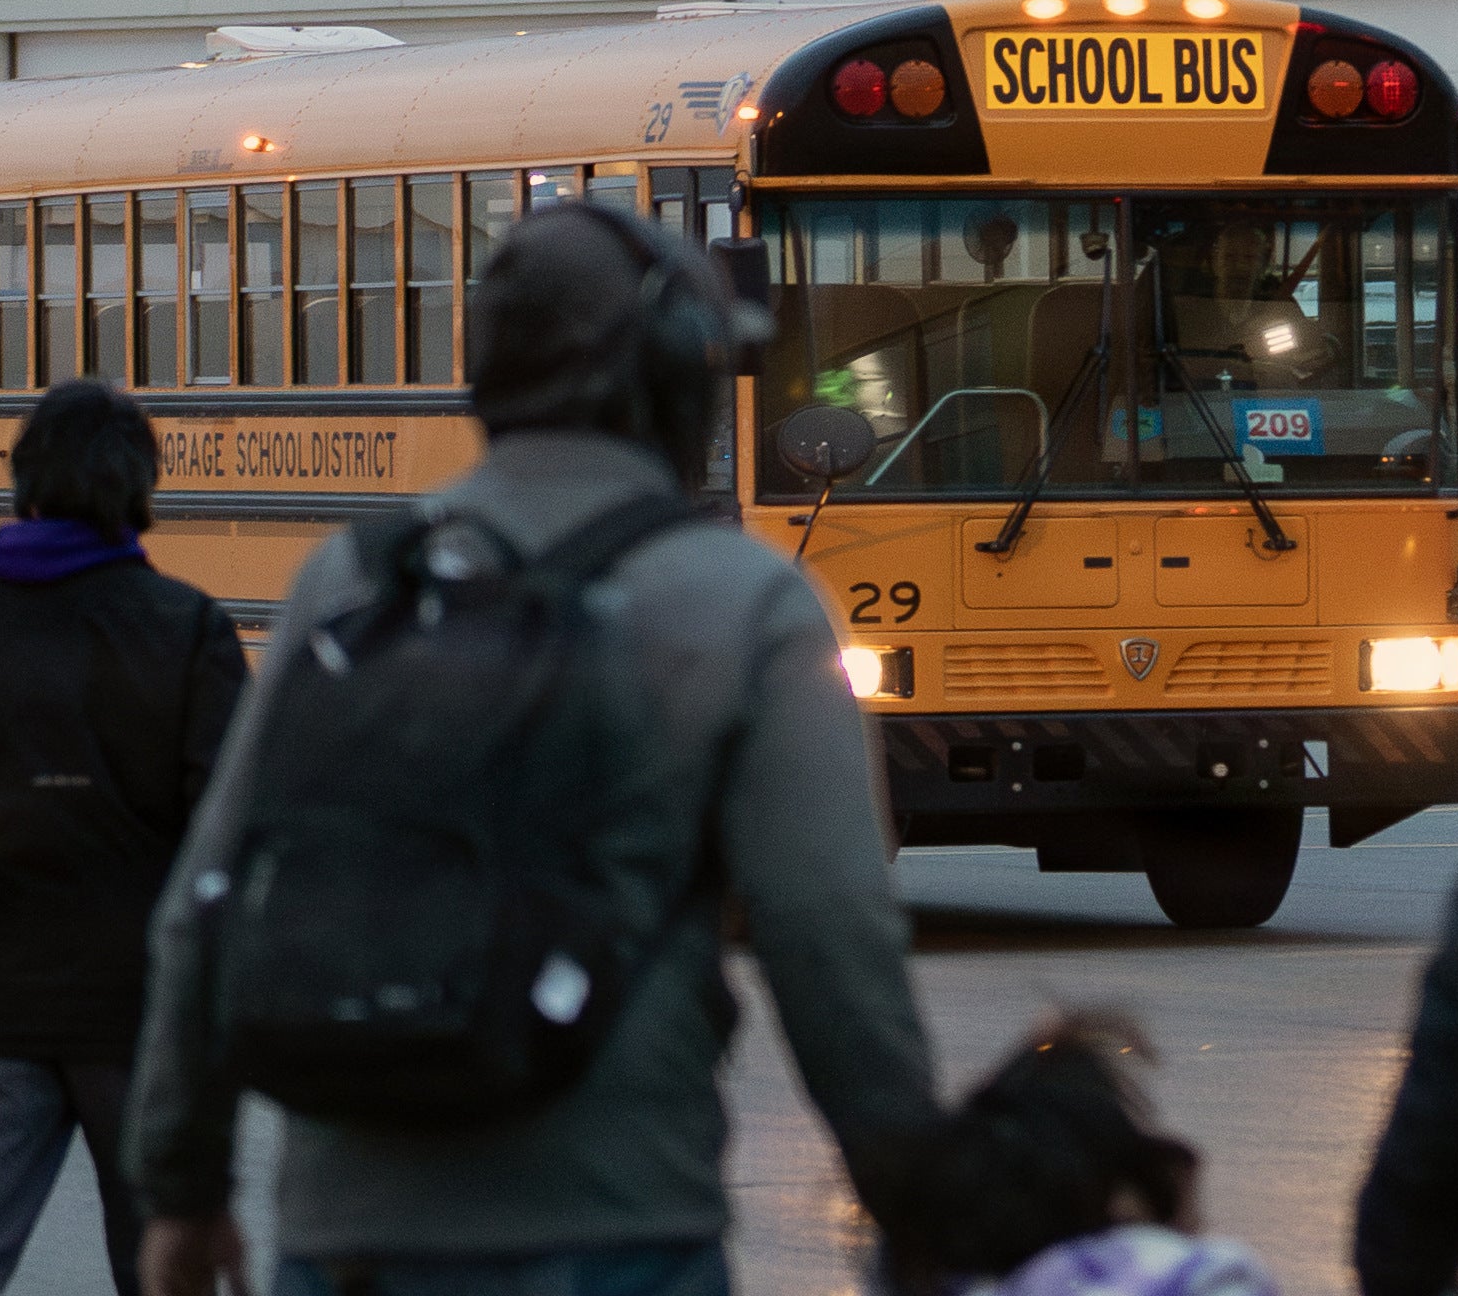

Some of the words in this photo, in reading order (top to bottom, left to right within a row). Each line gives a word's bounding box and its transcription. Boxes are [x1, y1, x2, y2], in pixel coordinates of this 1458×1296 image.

[992, 37, 1163, 105] SCHOOL
[1174, 37, 1260, 105] BUS
[644, 102, 673, 143] 29
[1247, 412, 1310, 439] 209
[157, 431, 225, 478] ORAGE
[235, 430, 309, 478] SCHOOL
[311, 430, 397, 479] DISTRICT
[848, 581, 922, 624] 29
